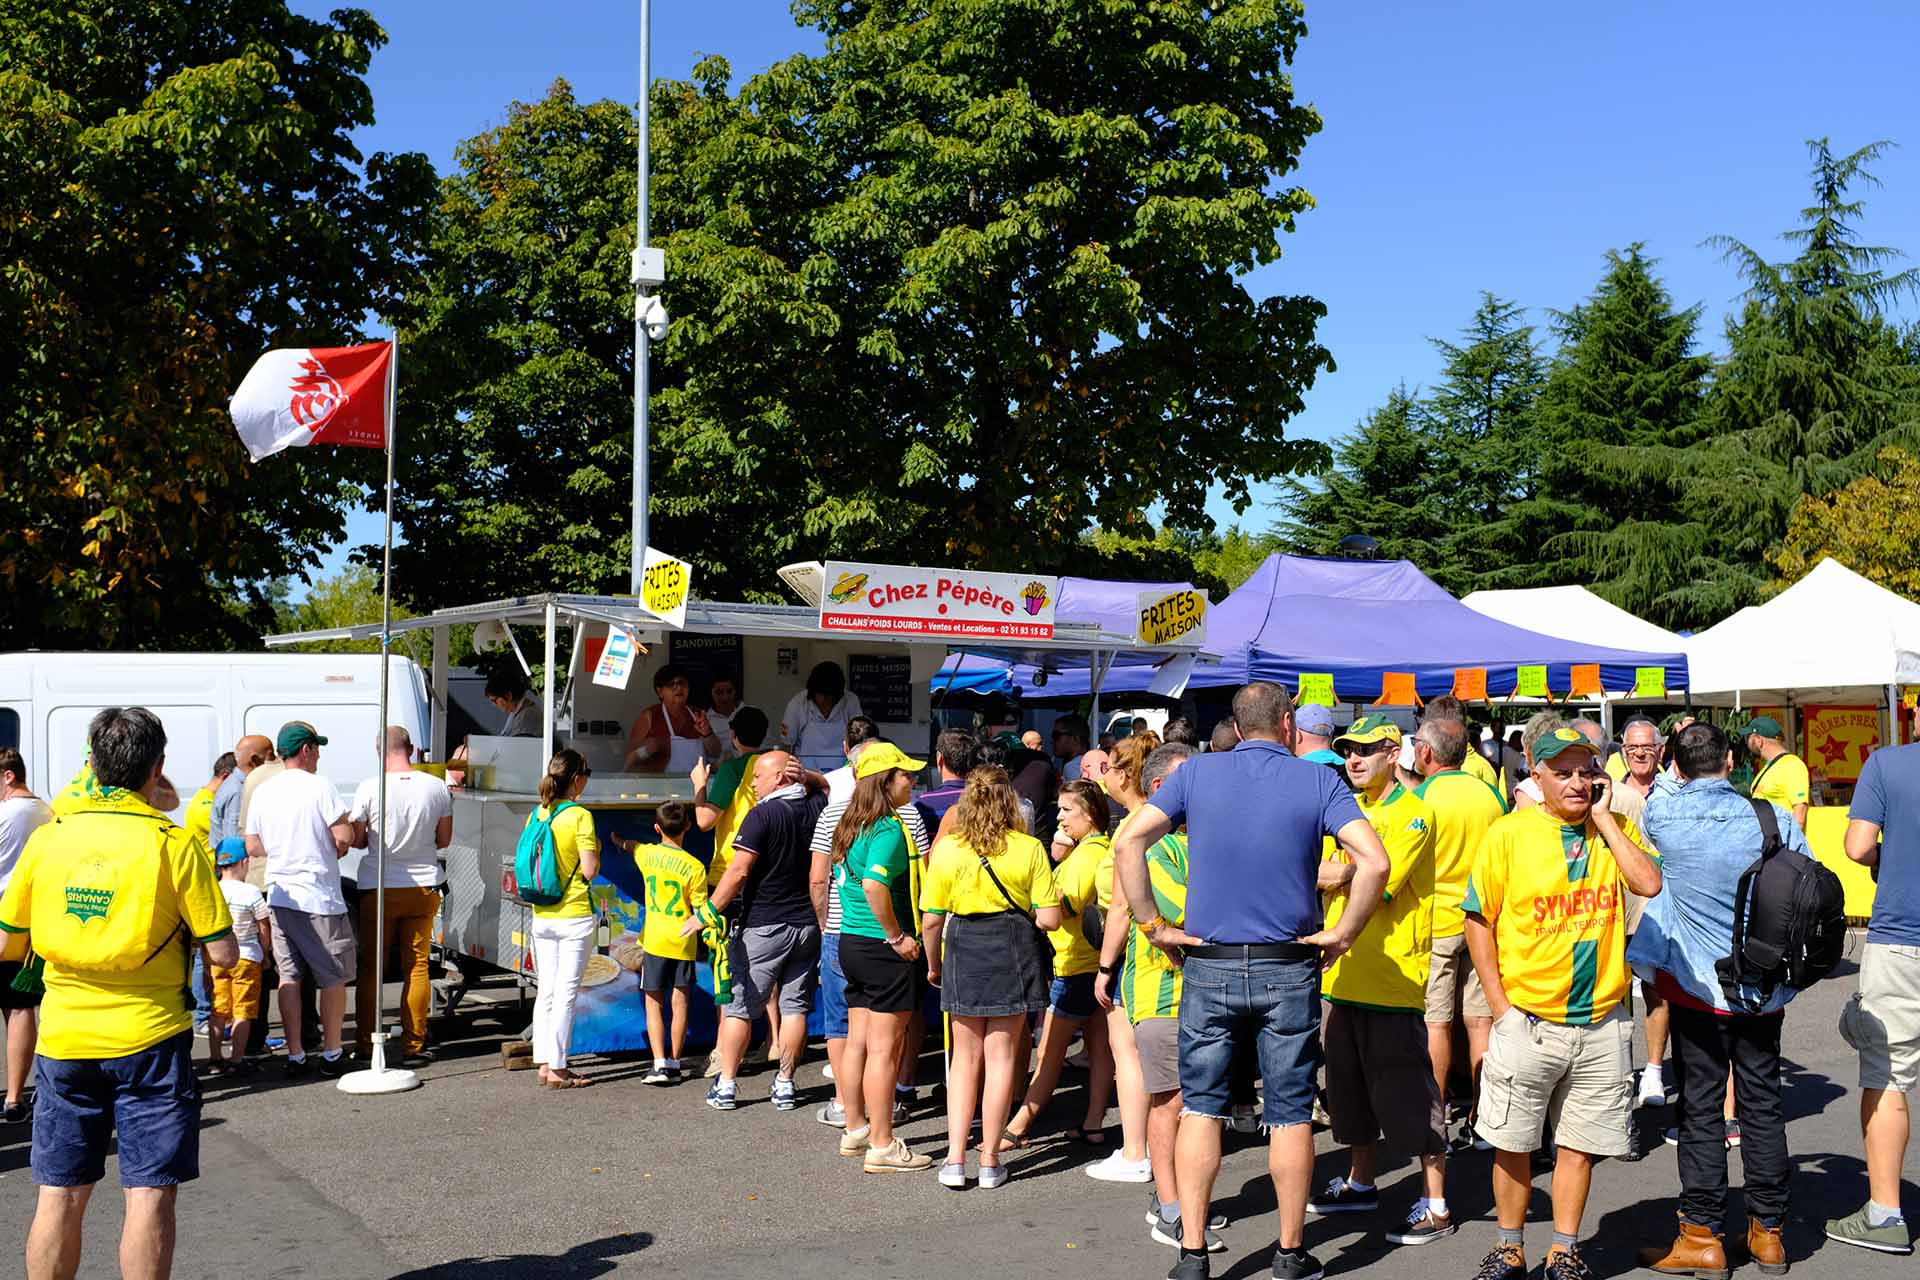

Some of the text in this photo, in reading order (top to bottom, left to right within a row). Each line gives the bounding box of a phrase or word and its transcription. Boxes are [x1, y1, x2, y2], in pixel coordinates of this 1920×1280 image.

[643, 561, 681, 592] FRITES
[650, 592, 683, 610] MAISON
[868, 578, 1015, 615] Chez Pépère
[1141, 591, 1195, 632] FRITES
[828, 617, 868, 626] CHALLANS
[869, 619, 892, 628] POIDS
[893, 620, 922, 630] LOURDS
[928, 621, 952, 632] Ventes
[953, 623, 961, 632] et
[962, 623, 995, 633] Locations
[1000, 626, 1009, 634] 02
[1010, 626, 1018, 635] 51
[1019, 626, 1029, 635] 93
[1030, 627, 1038, 635] 15
[1154, 613, 1202, 645] MAISON
[674, 636, 737, 649] SANDWICHS
[881, 664, 912, 673] MAISON
[1850, 714, 1878, 731] PRES
[67, 892, 111, 905] CANARIS
[646, 875, 684, 917] 12
[1533, 883, 1618, 923] SYNERGI
[1534, 922, 1572, 938] TRAVAIL
